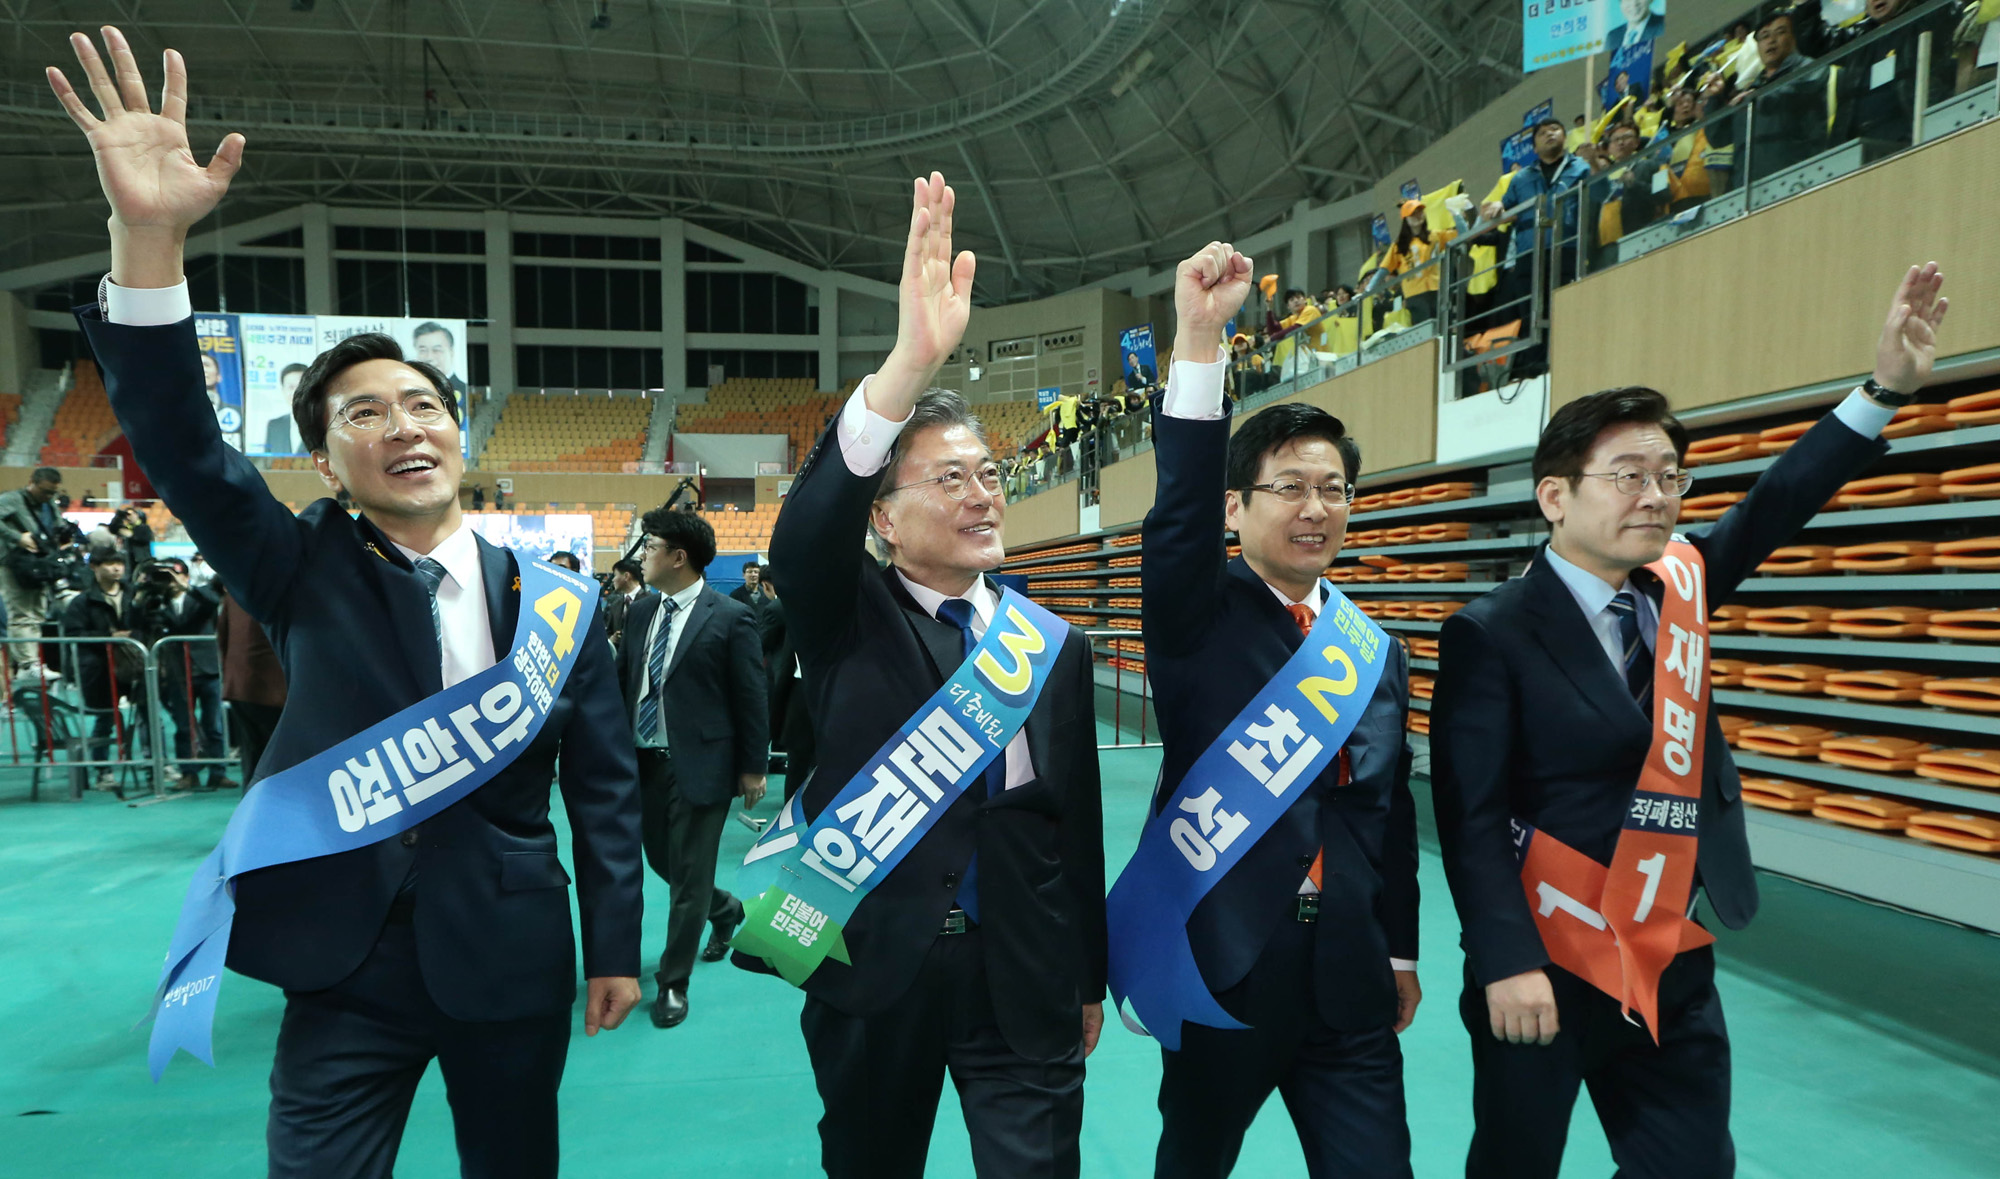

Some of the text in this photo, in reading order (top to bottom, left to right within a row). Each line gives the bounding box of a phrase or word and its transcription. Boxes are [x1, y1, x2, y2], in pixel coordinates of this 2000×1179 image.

[195, 319, 228, 336] 실한
[198, 337, 235, 353] 카드
[1120, 332, 1132, 350] 4
[222, 412, 233, 425] 4
[534, 586, 582, 661] 4
[972, 603, 1047, 697] 3
[1333, 608, 1376, 665] 민주당
[1339, 597, 1380, 652] 더불어
[513, 646, 553, 715] 생각하면
[527, 630, 560, 688] 한번 더
[1296, 645, 1358, 725] 2
[1662, 555, 1705, 777] 이재명
[961, 691, 1004, 749] 준비된
[328, 681, 535, 833] 안희정
[800, 705, 985, 893] 문재인
[1630, 797, 1698, 831] 적폐청산
[781, 892, 829, 932] 더불어
[1536, 880, 1608, 932] 1
[1633, 852, 1666, 924] 1
[769, 910, 818, 948] 민주당
